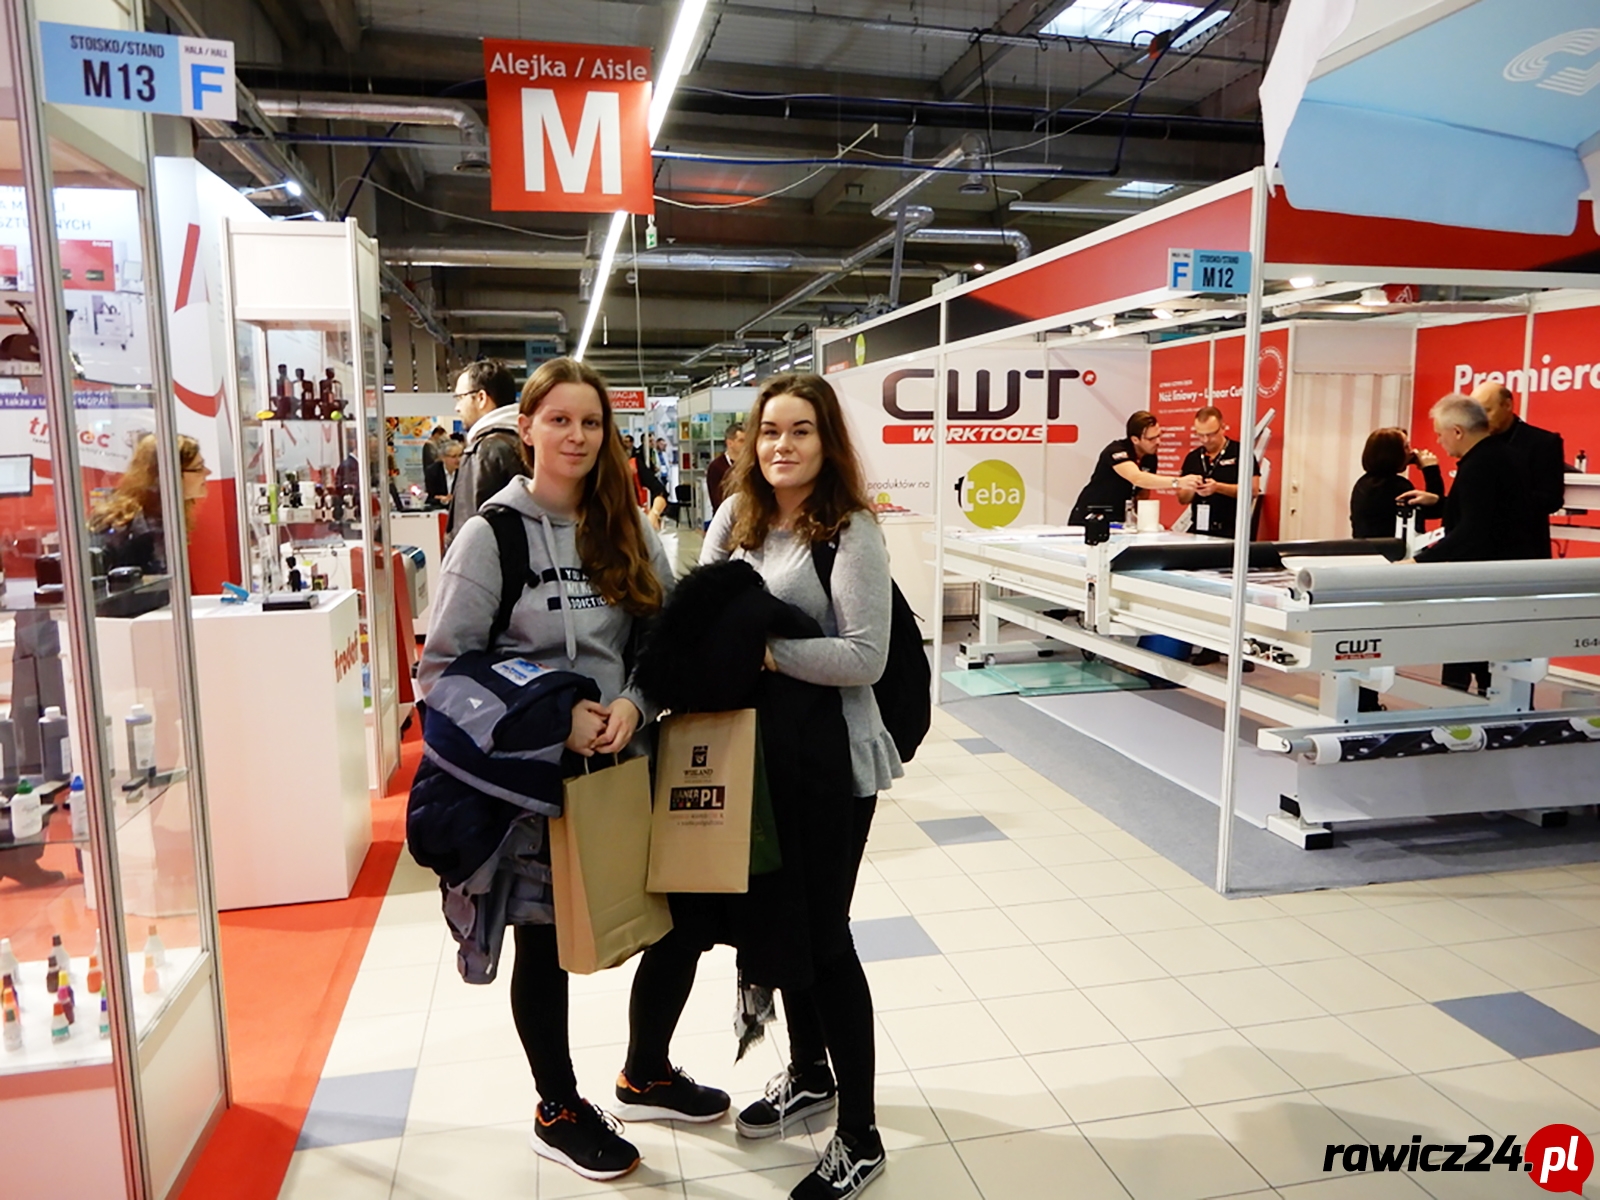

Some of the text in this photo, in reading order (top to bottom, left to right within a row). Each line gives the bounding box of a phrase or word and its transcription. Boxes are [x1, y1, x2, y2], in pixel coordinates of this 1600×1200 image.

[70, 35, 165, 58] STOISKO/STAND
[184, 45, 203, 55] HALA
[211, 49, 228, 58] HALL
[490, 52, 648, 81] Alejka / Aisle
[82, 59, 156, 102] M13
[190, 64, 225, 110] F
[521, 87, 623, 195] M
[1173, 262, 1189, 288] F
[1202, 267, 1234, 288] M12
[882, 368, 1081, 421] CWT
[867, 478, 931, 490] produktów na
[1335, 638, 1383, 655] CWT
[699, 788, 722, 808] PL
